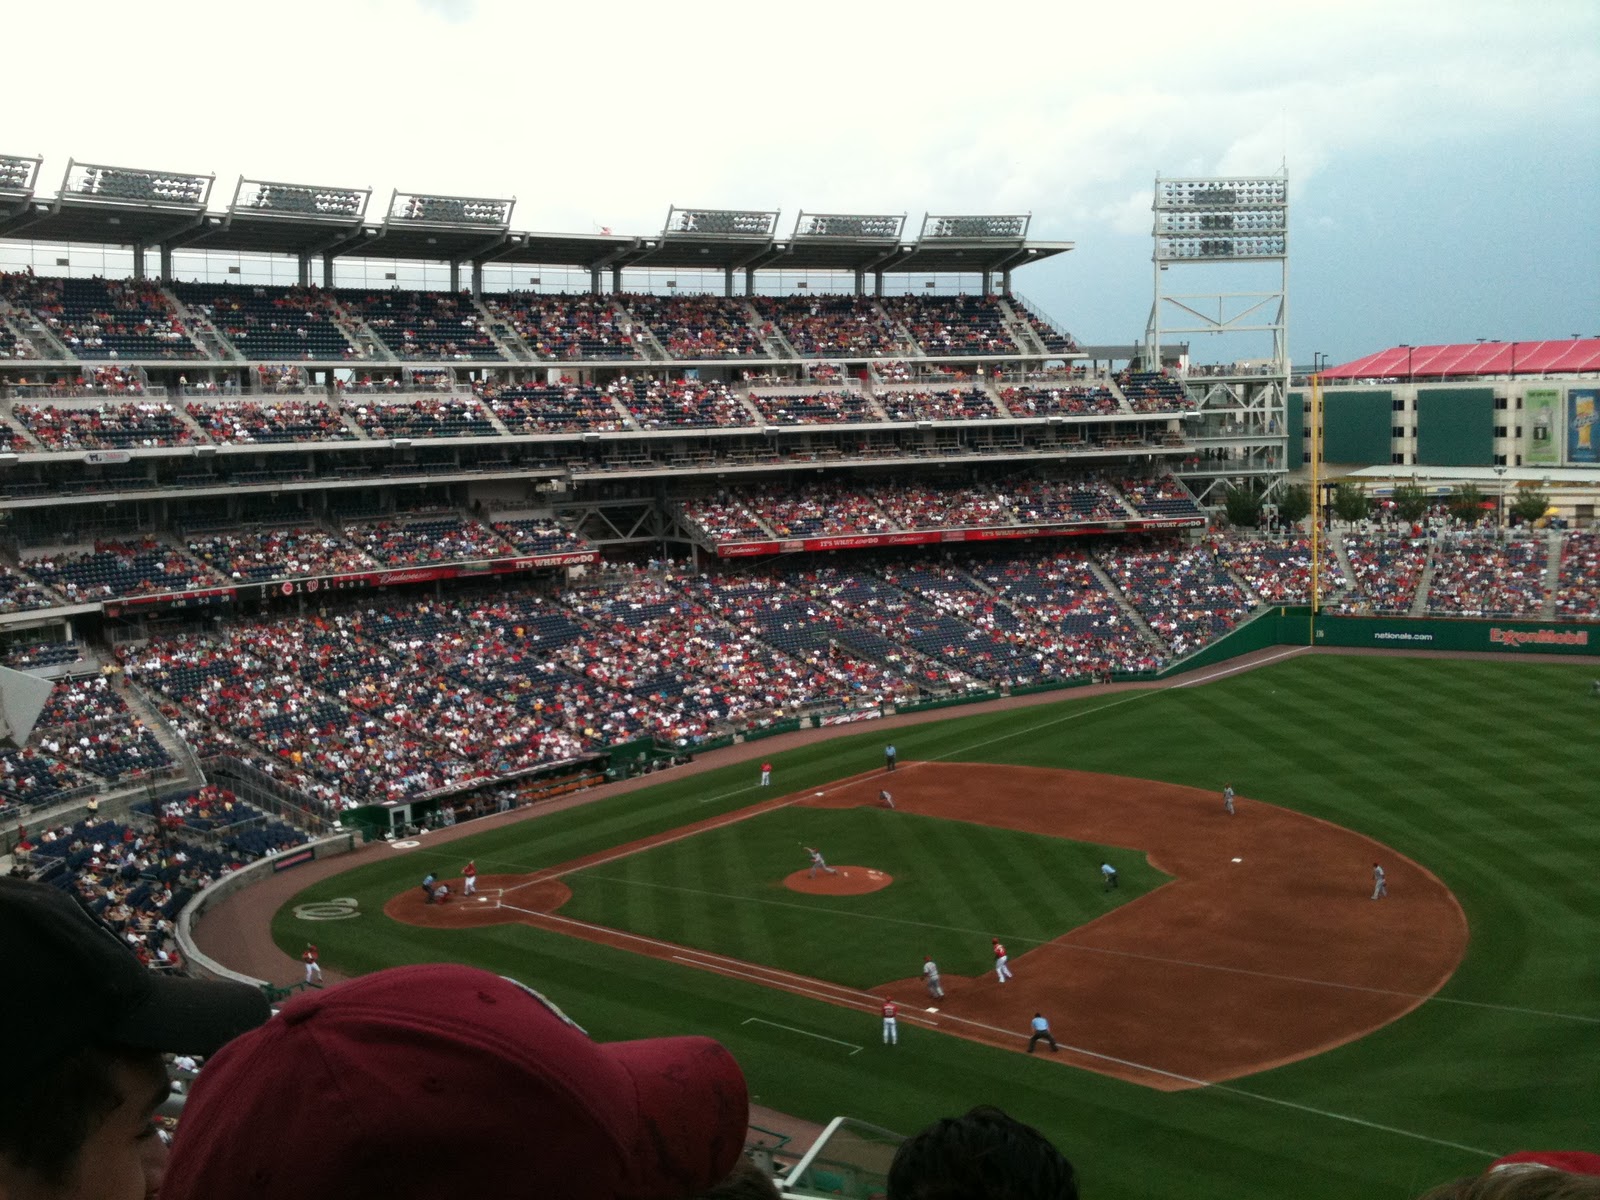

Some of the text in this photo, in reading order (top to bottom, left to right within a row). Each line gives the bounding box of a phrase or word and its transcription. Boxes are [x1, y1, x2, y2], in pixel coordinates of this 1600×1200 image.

[515, 560, 532, 569] IT'S
[533, 557, 562, 568] WHAT
[378, 572, 432, 584] Budweiser
[1374, 632, 1433, 641] nationals.com
[1490, 628, 1588, 646] ExxonMobil
